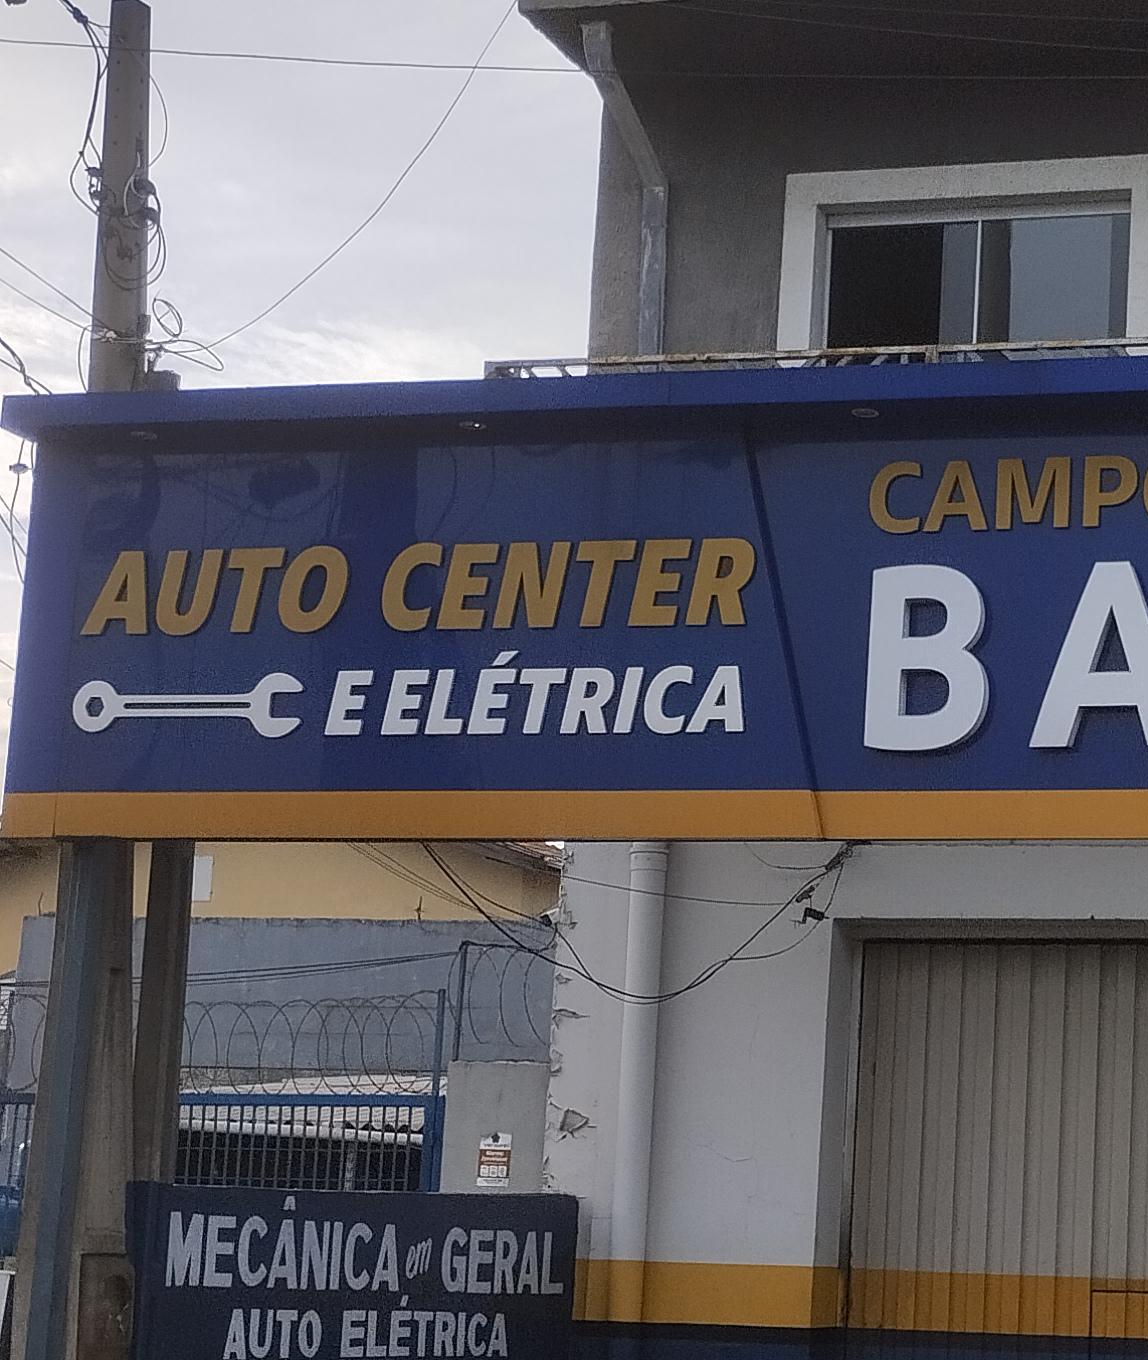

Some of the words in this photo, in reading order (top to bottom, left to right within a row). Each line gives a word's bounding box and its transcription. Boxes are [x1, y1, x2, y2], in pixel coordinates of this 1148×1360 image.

[80, 545, 350, 637] AUTO
[380, 537, 756, 632] CENTER
[324, 670, 373, 737] E
[381, 650, 746, 736] ELÉTRICA
[164, 1195, 400, 1291] MECÂNICA
[404, 1238, 432, 1280] em
[440, 1227, 564, 1296] GERAL
[222, 1307, 323, 1360] AUTO
[339, 1295, 509, 1358] ELÉTRICA
